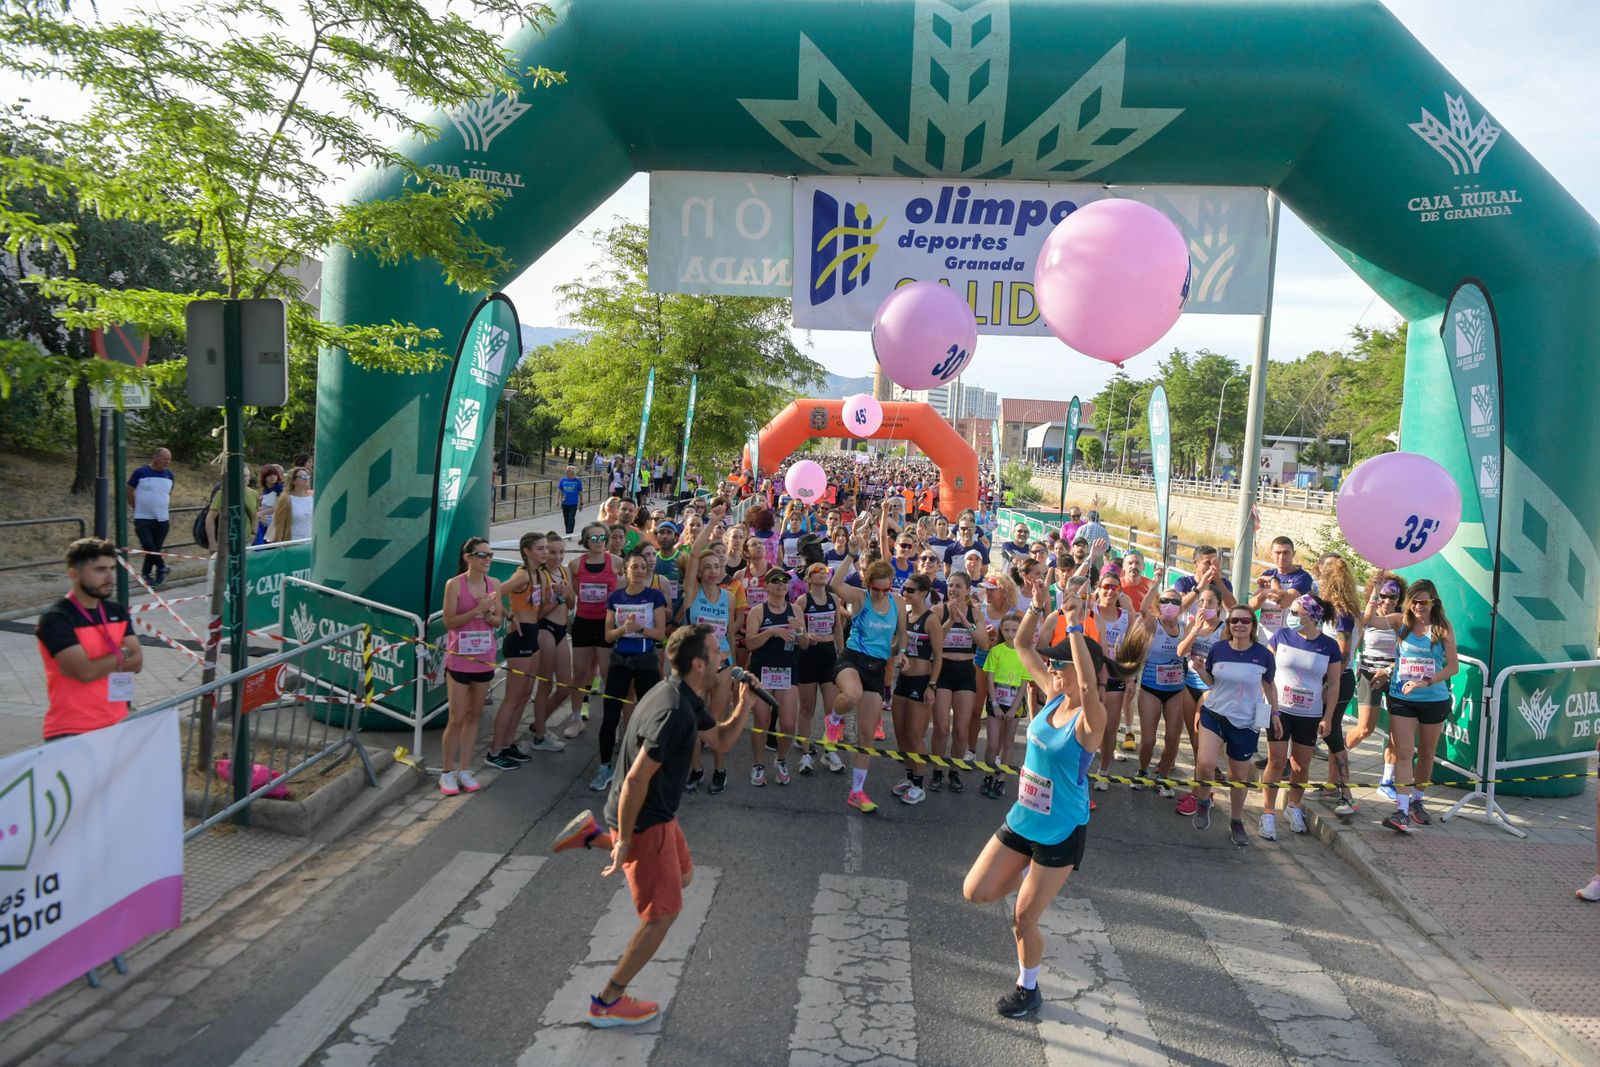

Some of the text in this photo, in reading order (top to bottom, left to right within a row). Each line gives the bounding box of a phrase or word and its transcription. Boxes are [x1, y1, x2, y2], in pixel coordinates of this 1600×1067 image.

[469, 167, 525, 187] RURAL
[1408, 190, 1522, 211] CAJA RURAL
[905, 186, 1077, 236] olimpo
[1420, 206, 1512, 222] DE GRANADA
[898, 230, 1008, 253] deportes
[945, 256, 1025, 271] Granada
[1395, 515, 1440, 553] 35'
[700, 606, 725, 615] nerja
[1565, 692, 1600, 717] CAJA
[1572, 720, 1590, 737] DE
[1024, 783, 1037, 796] 1197
[35, 873, 59, 899] la
